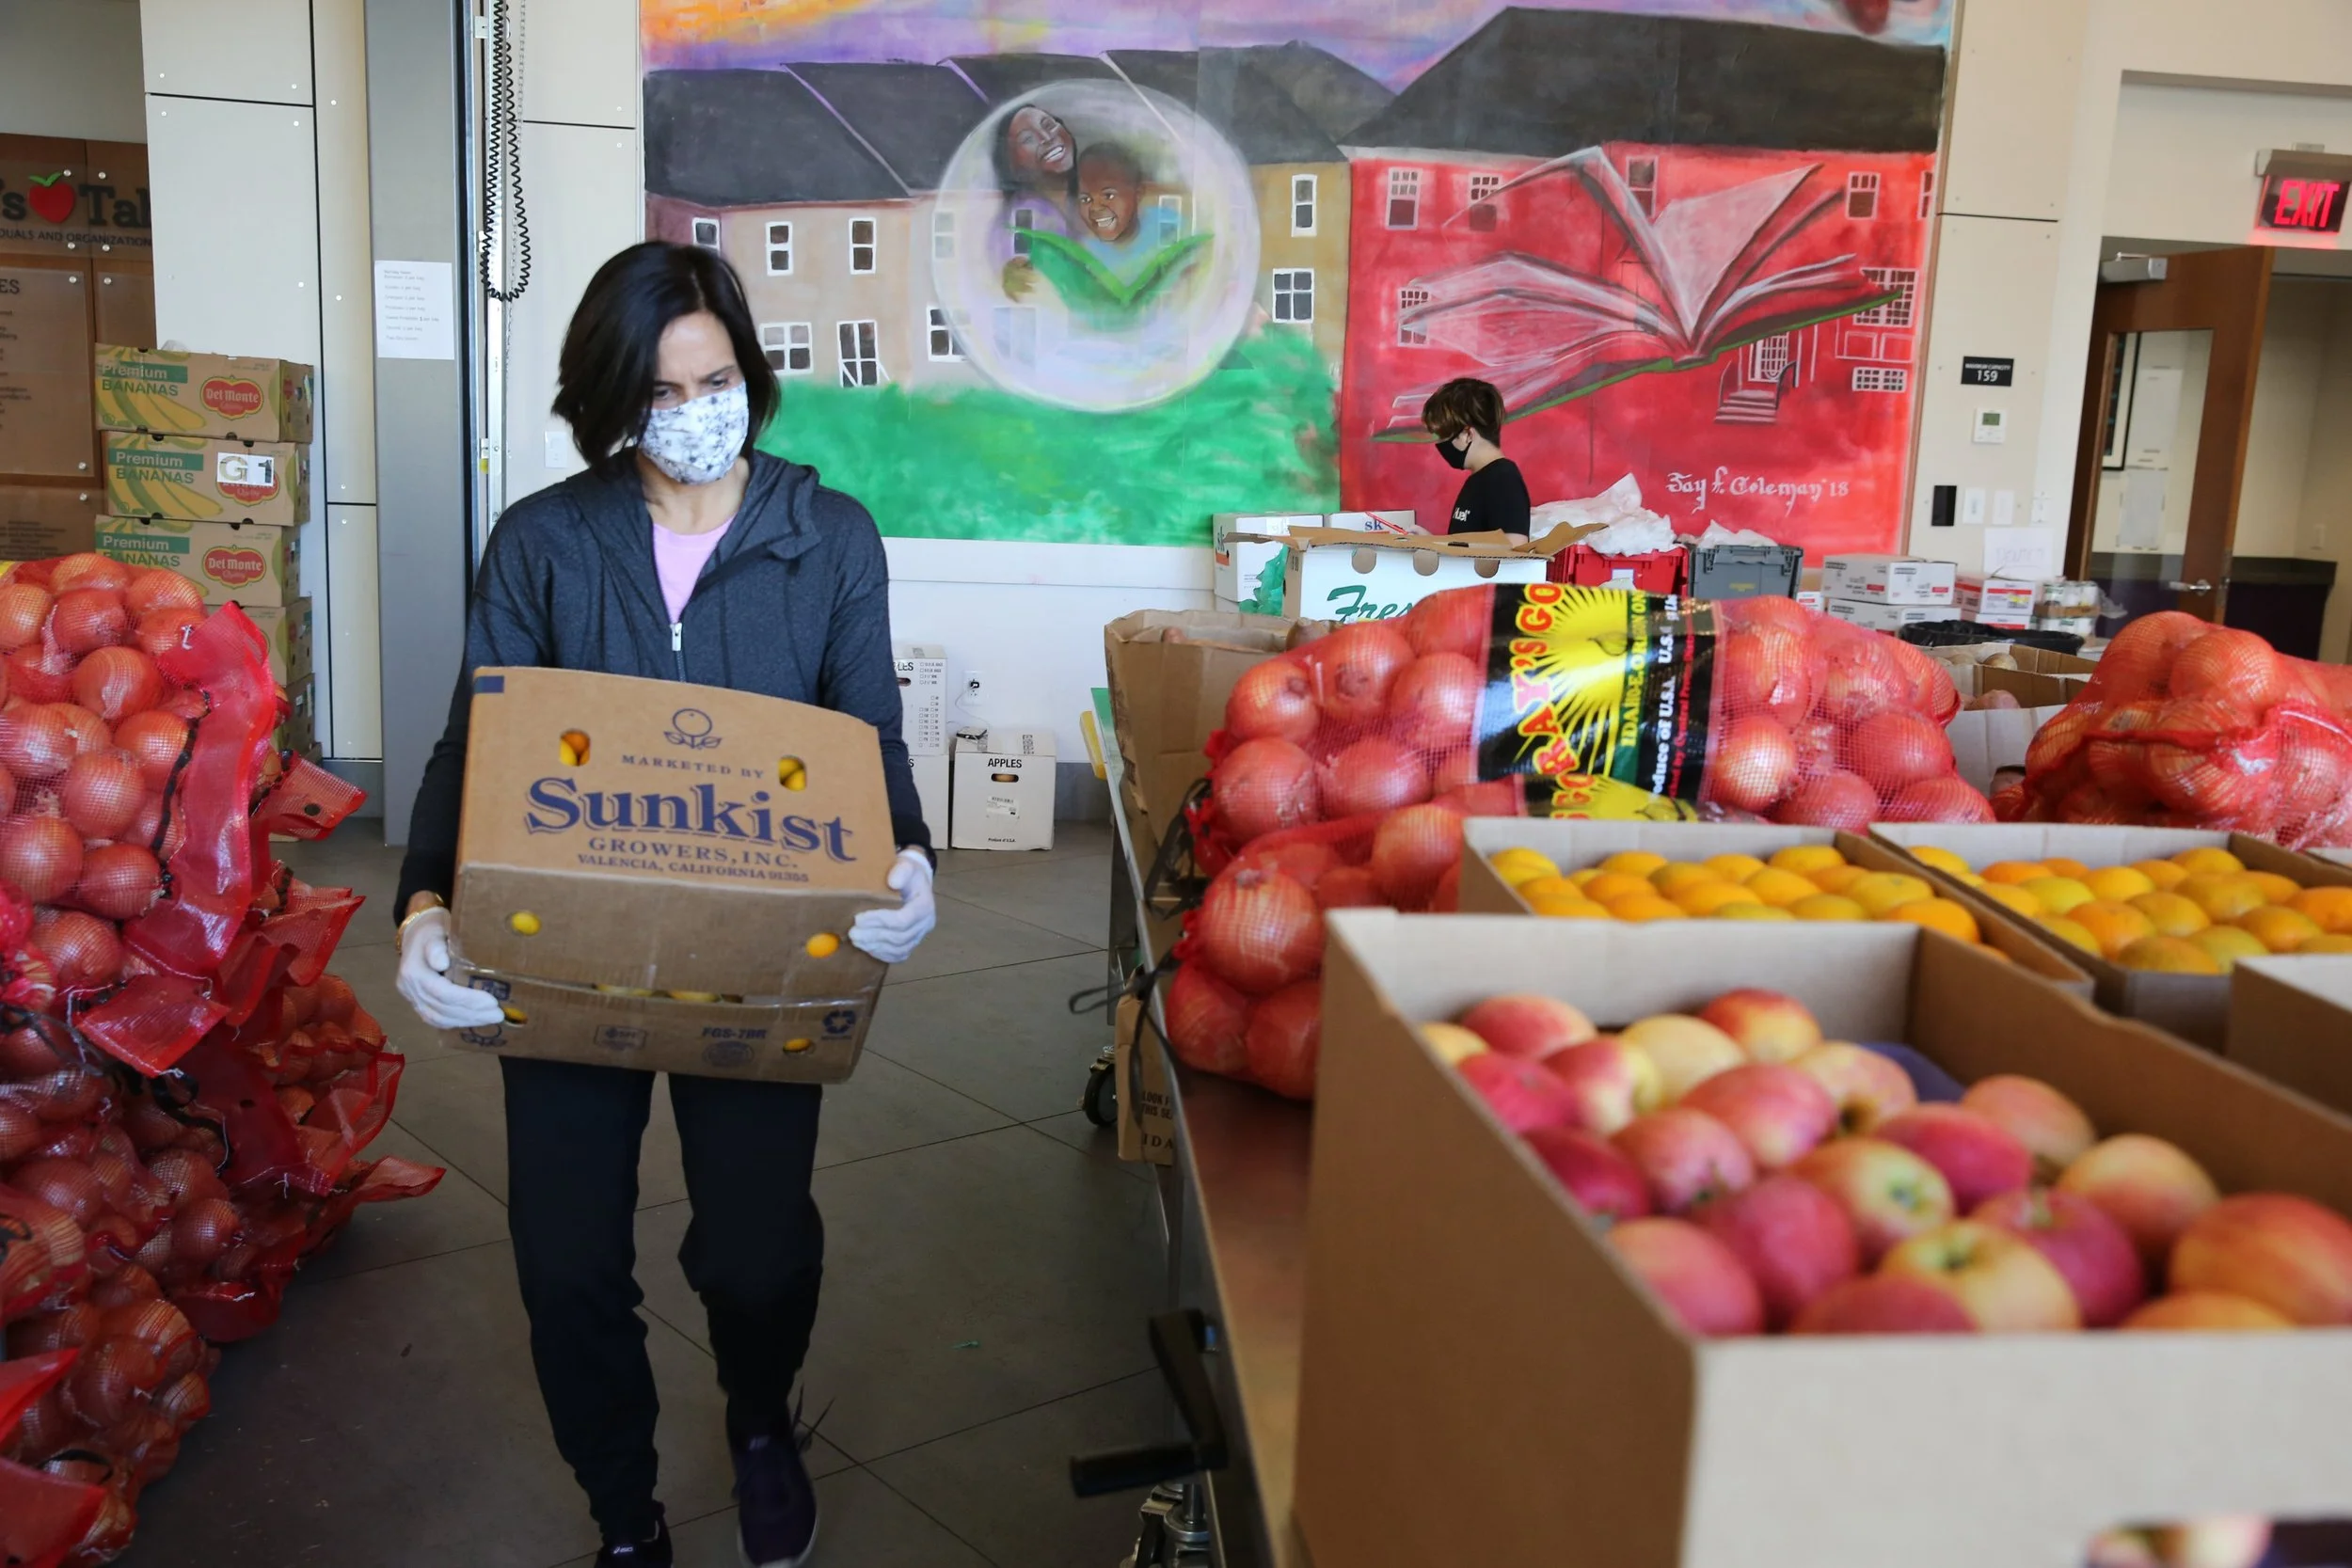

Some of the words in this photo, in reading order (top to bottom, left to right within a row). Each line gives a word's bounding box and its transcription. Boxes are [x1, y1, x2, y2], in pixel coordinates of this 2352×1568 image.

[2274, 180, 2340, 228] EXIT
[38, 230, 63, 242] AND
[102, 362, 167, 380] Premium
[1978, 370, 1998, 382] 159
[102, 379, 179, 396] BANANAS
[206, 388, 223, 401] Del
[225, 390, 260, 403] Monte
[116, 451, 183, 468] Premium
[116, 468, 195, 484] BANANAS
[1666, 472, 1707, 514] Jay
[1729, 476, 1822, 516] Coleman
[1364, 516, 1385, 531] sk
[103, 535, 169, 551] Premium
[208, 558, 226, 570] Del
[227, 559, 262, 571] Monte
[1509, 637, 1581, 776] RAY'S
[1655, 720, 1672, 740] of
[622, 754, 731, 775] MARKETED
[741, 768, 764, 779] BY
[988, 758, 1023, 768] APPLES
[524, 777, 857, 864] Sunkist
[589, 836, 738, 865] GROWERS,
[742, 850, 798, 868] INC.
[578, 854, 664, 873] VALENCIA,
[668, 862, 767, 879] CALIFORNIA
